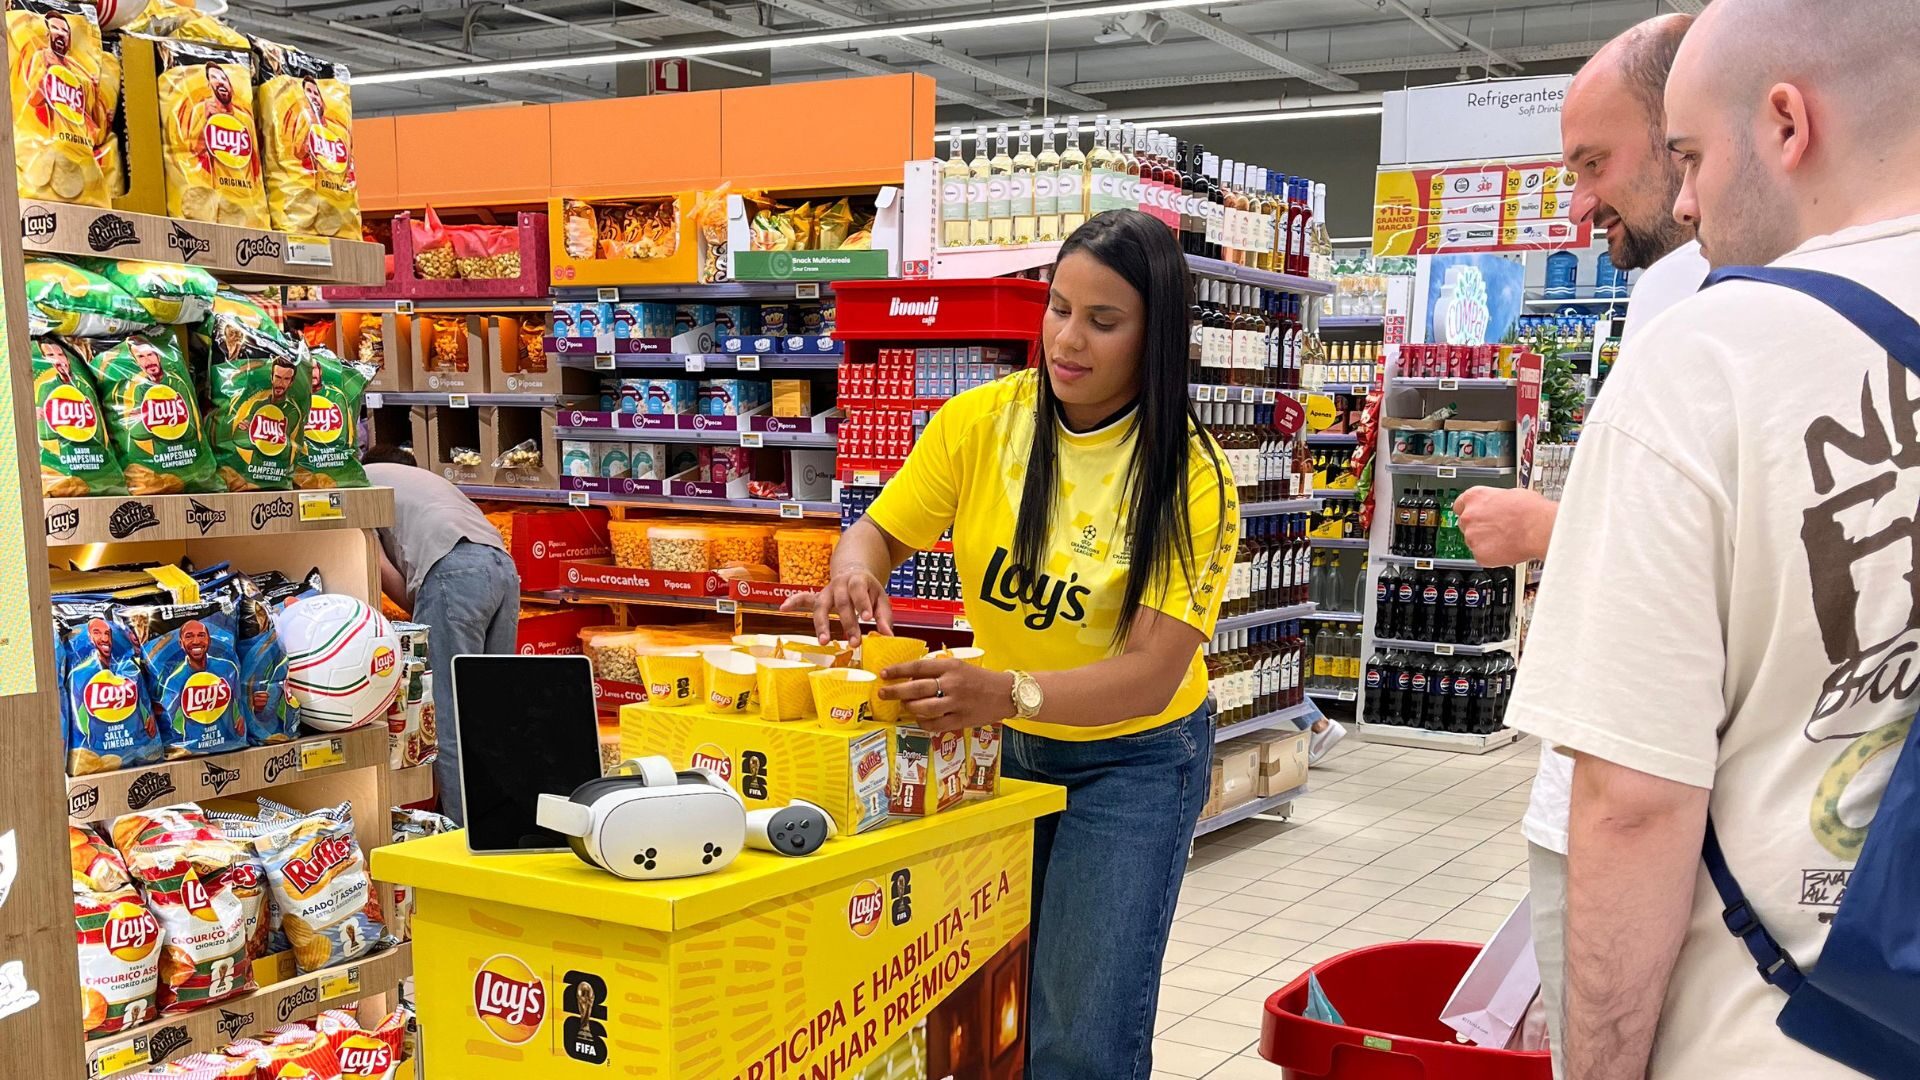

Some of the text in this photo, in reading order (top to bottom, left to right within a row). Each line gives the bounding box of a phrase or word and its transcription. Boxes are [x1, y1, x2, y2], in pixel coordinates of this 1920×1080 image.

[1468, 89, 1563, 109] Refrigerantes
[1518, 106, 1535, 116] Soft
[210, 125, 250, 155] Lay's
[1472, 204, 1495, 214] Comfort
[24, 214, 54, 236] Lay's
[92, 221, 134, 244] Ruffles
[169, 233, 210, 252] Doritos
[236, 236, 281, 266] Cheetos
[889, 296, 940, 317] Buondi
[440, 378, 464, 387] Pipocas
[518, 379, 543, 388] Pipocas
[51, 398, 94, 428] Lay's
[147, 394, 186, 427] Lay's
[1310, 410, 1331, 418] Apenas
[252, 415, 285, 444] Lay's
[60, 455, 104, 465] CAMPESINAS
[153, 448, 197, 464] CAMPESINAS
[308, 452, 349, 464] CAMPESINAS
[113, 503, 155, 532] Ruffles
[186, 509, 226, 524] Doritos
[251, 497, 294, 530] Cheetos
[47, 511, 77, 535] Lay's
[1070, 541, 1100, 554] CHAMPIONS
[1074, 548, 1093, 557] LEAGUE
[581, 575, 596, 583] Leves
[600, 574, 650, 587] crocantes
[664, 579, 691, 590] Pipocas
[979, 545, 1091, 631] Lay's
[752, 588, 769, 596] Leves
[375, 652, 394, 672] Lay's
[90, 680, 136, 710] Lay's
[187, 679, 229, 713] Lay's
[605, 690, 620, 698] Leves
[625, 691, 648, 700] croc
[651, 683, 671, 695] Lay's
[712, 691, 732, 705] Lay's
[831, 707, 854, 719] Lay's
[103, 738, 135, 750] VINEGAR
[105, 730, 130, 740] SALT &
[198, 737, 225, 749] VINEGAR
[202, 733, 216, 741] SALT
[857, 750, 882, 779] Ruffles
[902, 750, 922, 761] Doritos
[201, 768, 240, 786] Doritos
[133, 773, 172, 804] Ruffles
[749, 788, 762, 796] FIFA
[69, 790, 97, 815] Lay's
[281, 833, 351, 894] Ruffles
[235, 865, 257, 888] es
[1805, 871, 1847, 887] SNA
[187, 879, 210, 910] La
[302, 899, 334, 917] ASADO
[340, 880, 367, 899] ASSADO
[1803, 887, 1829, 903] ALL
[851, 890, 883, 925] Lay's
[896, 911, 907, 921] FIFA
[109, 911, 157, 949] Lay's
[246, 916, 257, 926] DO
[171, 930, 225, 945] CHOURIÇO
[195, 939, 224, 950] CHORIZO
[85, 966, 157, 986] CHOURIÇO ASS
[733, 869, 1009, 1080] RTICIPA E HABILITA-TE A
[110, 980, 140, 991] CHORIZO
[277, 985, 318, 1022] Cheetos
[478, 972, 543, 1026] Lay's
[798, 938, 971, 1080] NHAR PRÉMIOS
[217, 1011, 255, 1034] Doritos
[575, 1041, 597, 1057] FIFA
[89, 1060, 99, 1076] La
[340, 1045, 389, 1077] Lay's
